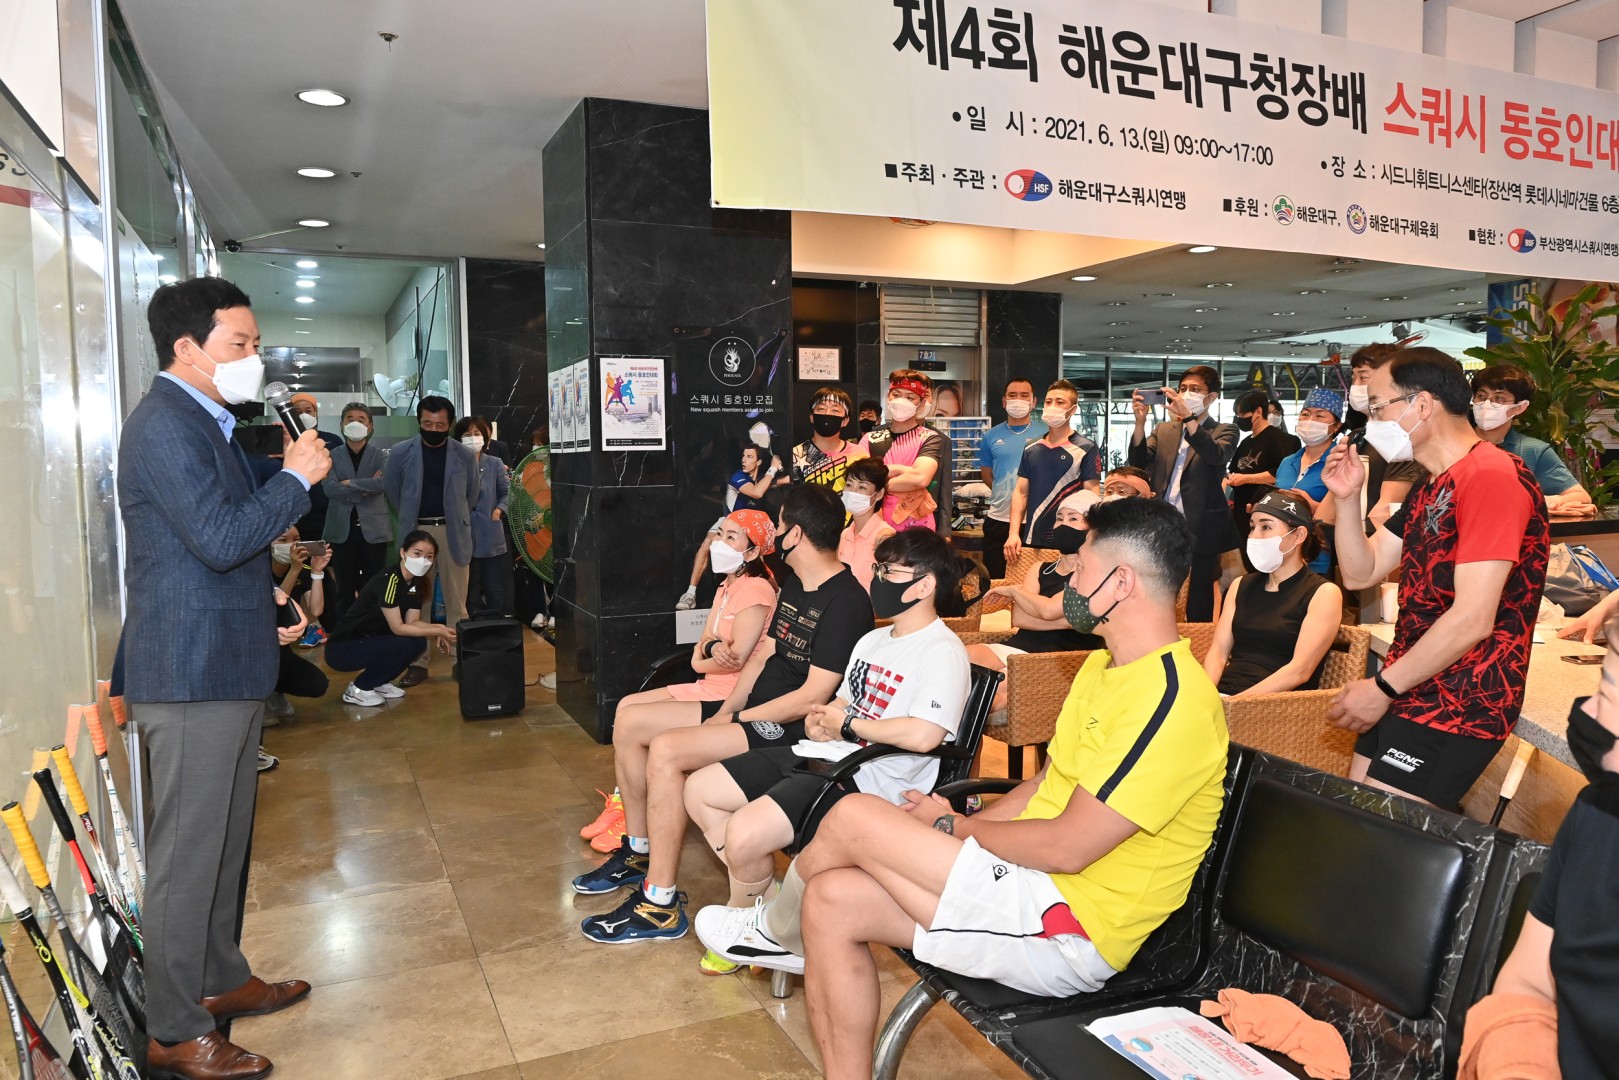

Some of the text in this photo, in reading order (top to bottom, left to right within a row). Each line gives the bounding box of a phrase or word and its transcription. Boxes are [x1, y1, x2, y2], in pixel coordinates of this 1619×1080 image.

[893, 0, 1038, 82] 제4회
[1058, 24, 1368, 134] 해운대구청장배
[1383, 82, 1486, 154] 스쿼시
[966, 105, 986, 132] 일
[1005, 111, 1024, 136] 시
[1045, 116, 1093, 144] 2021.
[1098, 124, 1114, 146] 6.
[1174, 134, 1274, 166] 09:00~17:00
[901, 162, 935, 186] 주최
[953, 167, 985, 190] 주관
[1034, 183, 1050, 194] HSF
[1058, 179, 1187, 210] 해운대구스쿼시연맹
[1331, 155, 1346, 178] 장
[1353, 159, 1368, 180] 소
[1525, 184, 1599, 213] 롯데시네마건물
[1234, 196, 1259, 217] 후원
[1369, 214, 1439, 239] 해운대구체육회
[1477, 228, 1496, 246] 협찬
[1539, 236, 1619, 258] 부산광역시스쿼시연맹
[690, 394, 773, 406] 스쿼시 동호인 모집
[703, 406, 721, 414] squash
[1386, 747, 1425, 768] PGNC
